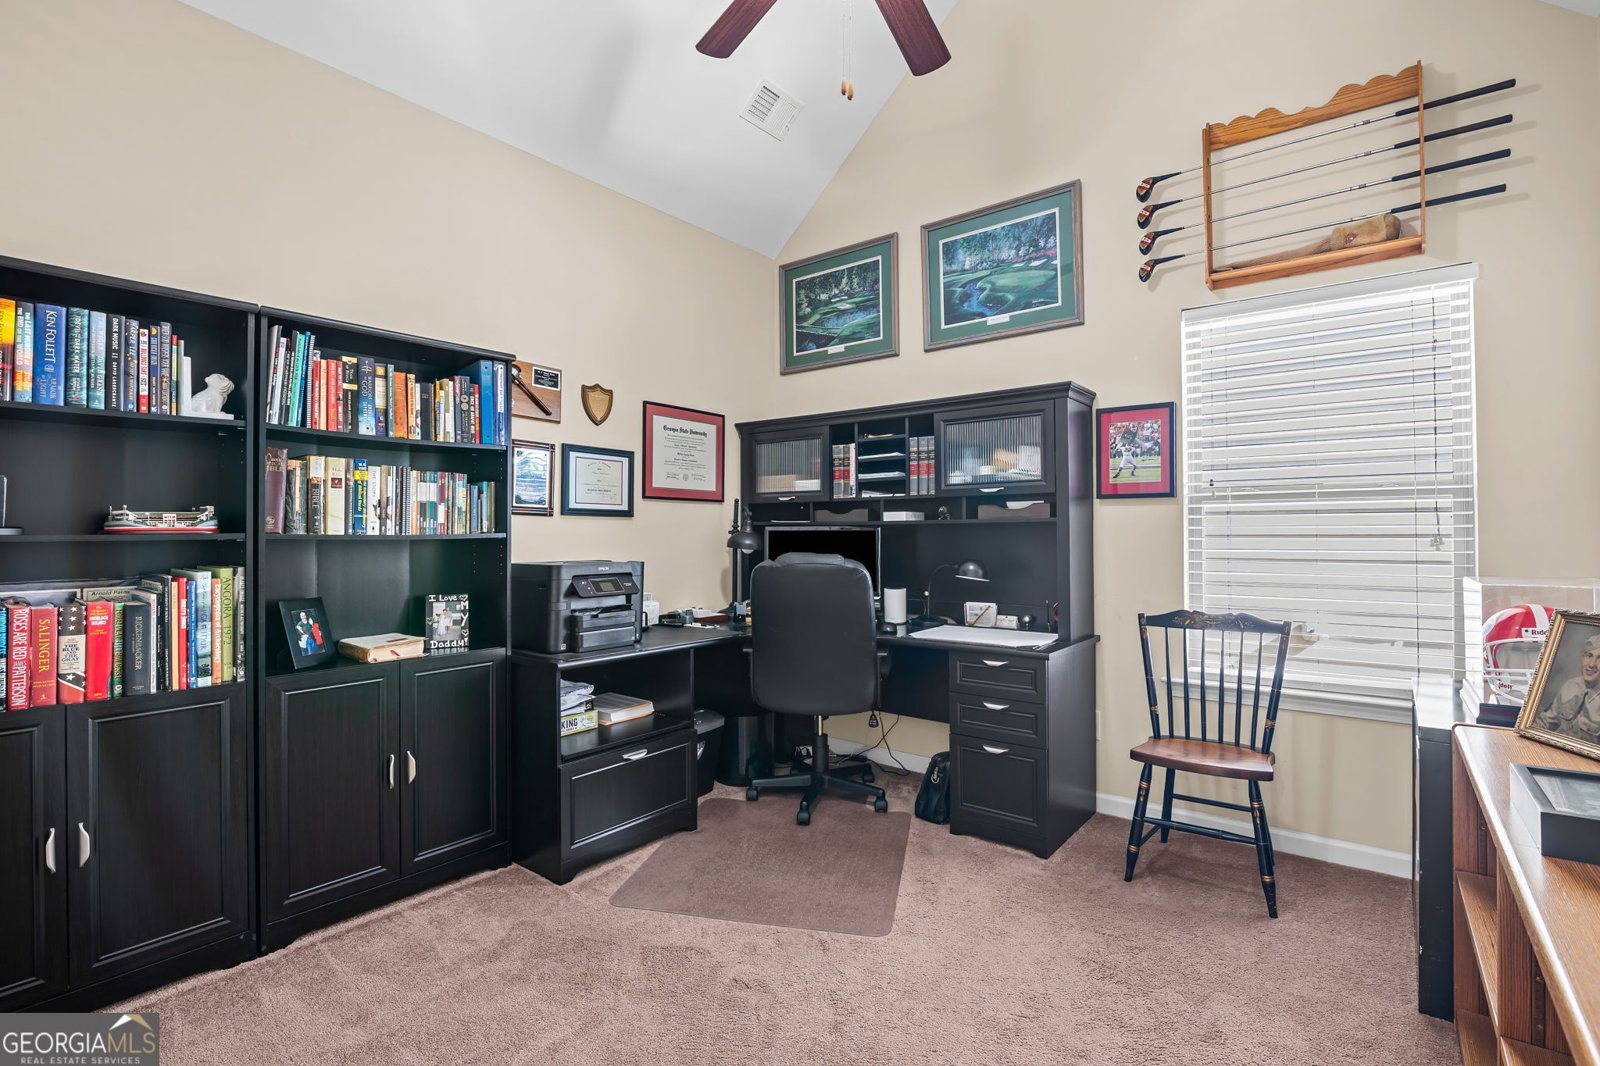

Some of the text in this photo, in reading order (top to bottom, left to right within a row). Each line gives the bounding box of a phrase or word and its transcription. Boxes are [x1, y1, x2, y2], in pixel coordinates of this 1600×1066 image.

[44, 310, 57, 363] KEN FOLLETT
[663, 425, 678, 433] Georgia
[690, 429, 707, 438] University
[12, 609, 28, 660] ROSES ARE RED
[38, 619, 50, 672] SALINGER
[134, 616, 143, 670] RICKENBACKER
[11, 667, 26, 705] PATTERSON
